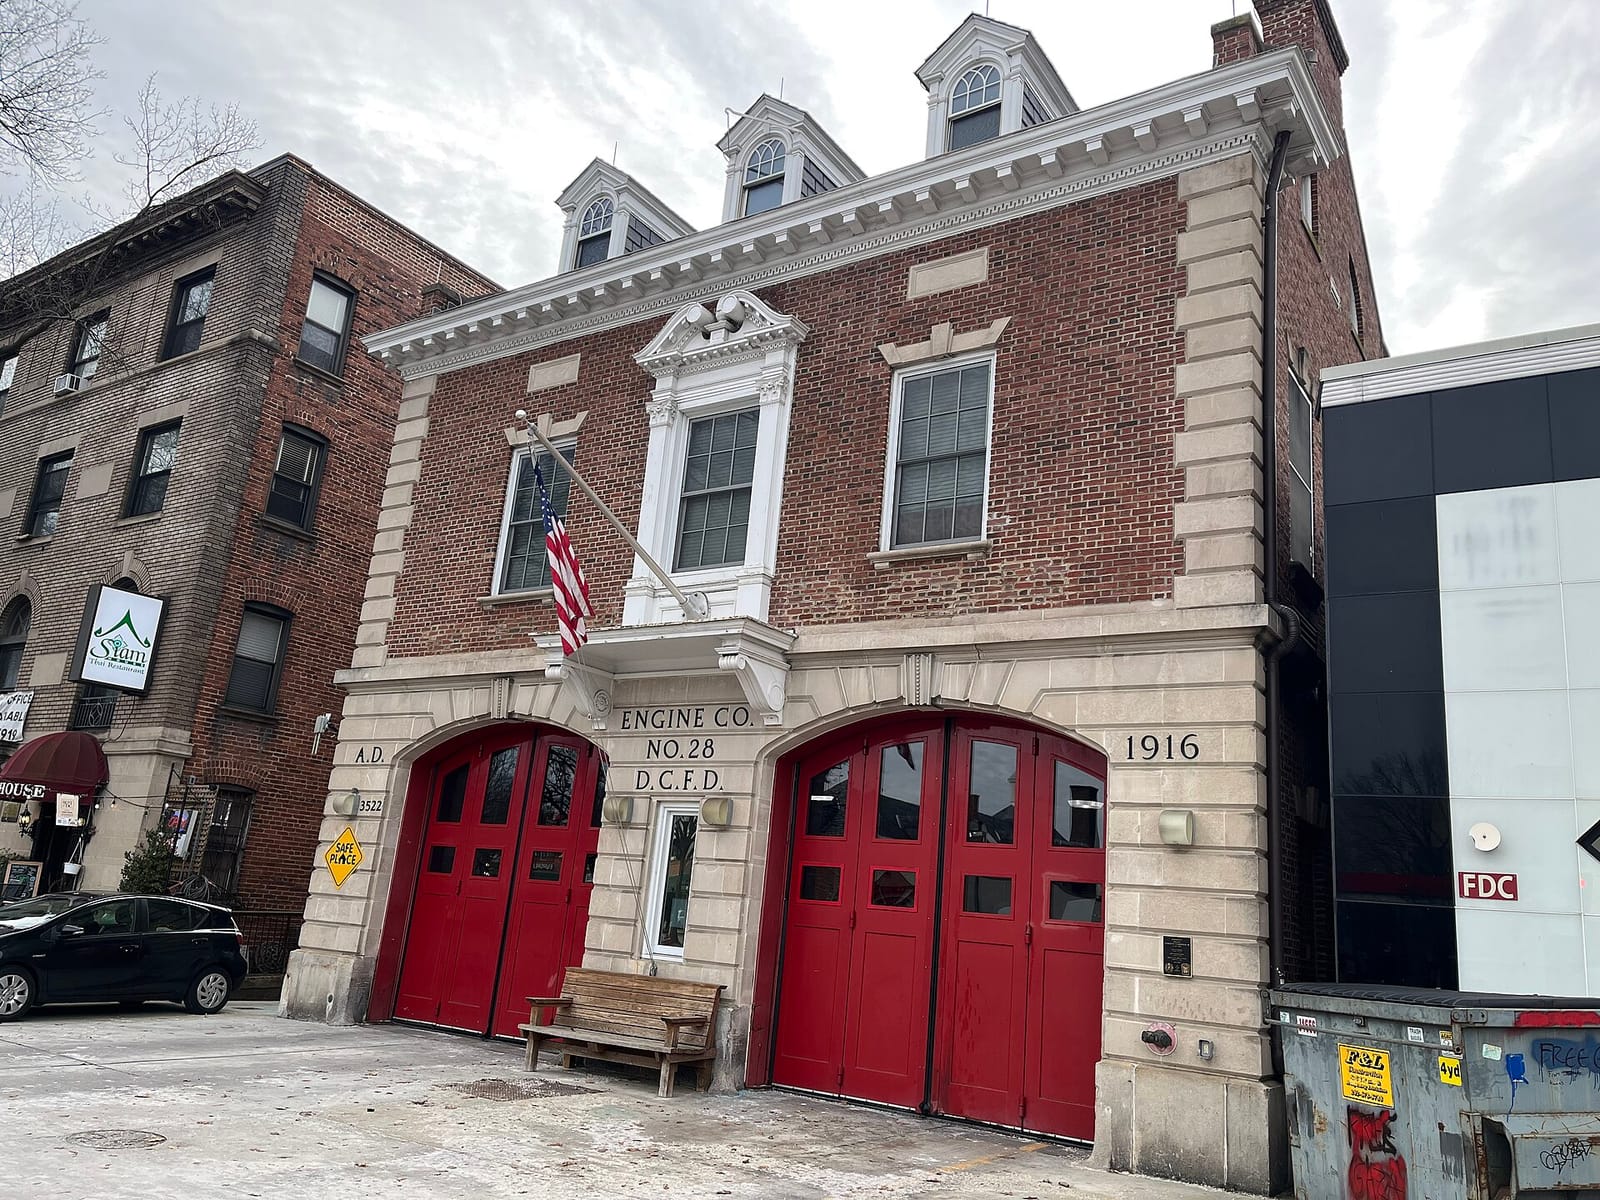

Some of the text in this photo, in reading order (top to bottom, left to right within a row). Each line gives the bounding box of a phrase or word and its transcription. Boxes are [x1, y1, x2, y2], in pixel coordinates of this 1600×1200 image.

[90, 638, 147, 663] Siam
[89, 657, 106, 668] Thai
[107, 661, 145, 675] Restaurant
[621, 706, 755, 730] ENGINE CO.
[355, 746, 385, 763] A.D.
[1126, 733, 1200, 760] 1916
[635, 769, 724, 791] D.C.F.D.
[0, 782, 46, 798] HOUSE
[359, 800, 383, 812] 3522
[335, 842, 355, 854] SAFE
[1463, 873, 1514, 899] FDC
[1440, 1061, 1460, 1079] 4yd
